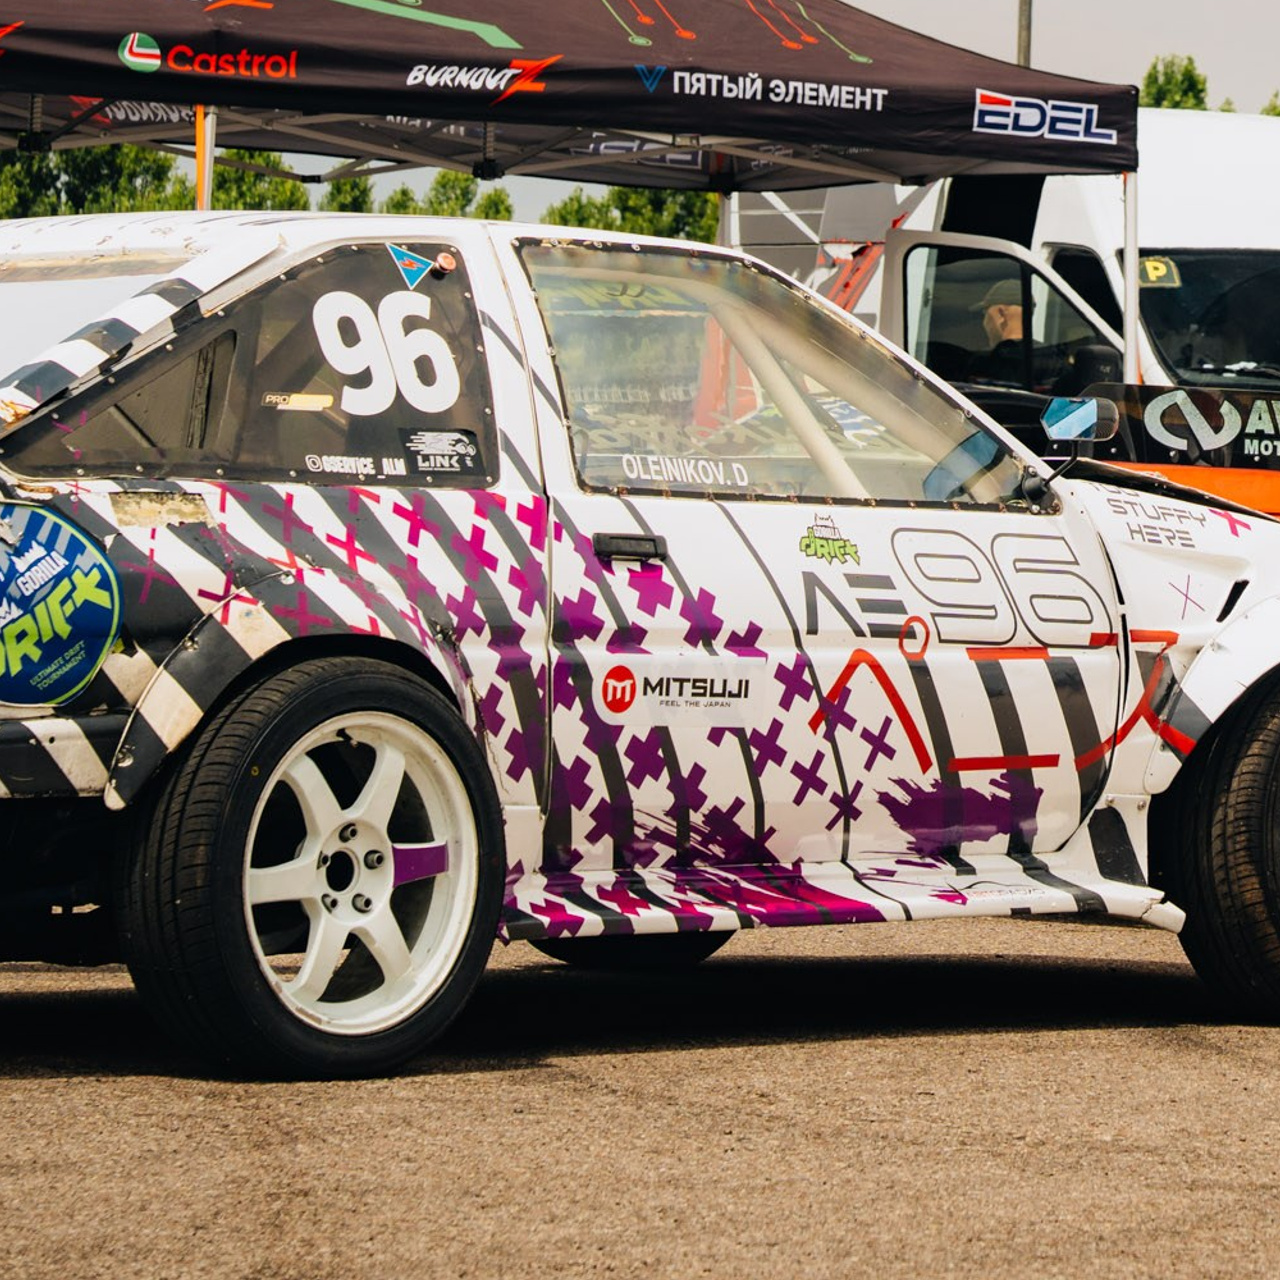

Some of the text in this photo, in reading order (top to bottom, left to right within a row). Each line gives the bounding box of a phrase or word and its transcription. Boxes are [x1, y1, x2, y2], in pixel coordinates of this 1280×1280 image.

[167, 45, 298, 78] Castrol
[673, 71, 889, 111] ПЯТЫЙ ЭЛЕМЕНТ
[972, 88, 1118, 145] EDEL
[312, 291, 461, 416] 96
[417, 455, 460, 468] LINK
[731, 462, 749, 486] D
[1107, 498, 1207, 527] STUFFY
[1126, 522, 1195, 548] HERE
[16, 550, 69, 597] GORILLA
[0, 567, 112, 677] RIFT
[30, 639, 86, 686] ULTIMATE DRIFT
[37, 650, 87, 692] TOURNAMENT
[643, 677, 749, 698] MITSUJI
